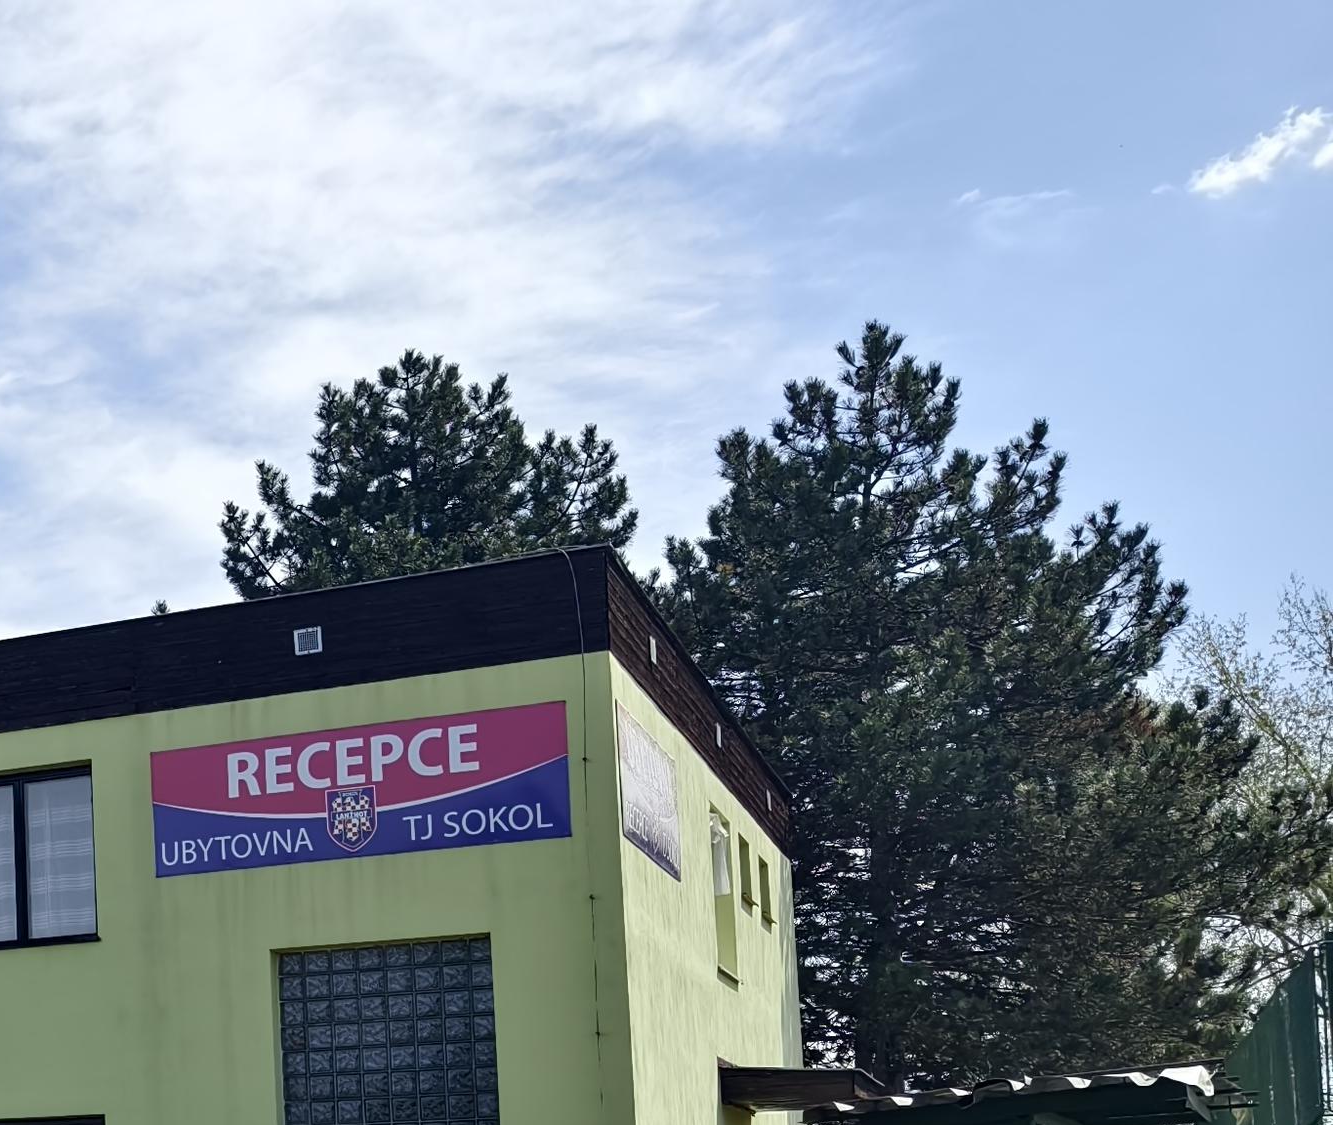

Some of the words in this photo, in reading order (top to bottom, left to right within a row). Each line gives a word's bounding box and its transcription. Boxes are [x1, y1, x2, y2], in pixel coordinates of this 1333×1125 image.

[226, 723, 481, 799] RECEPCE
[161, 827, 313, 867] UBYTOVNA
[403, 815, 433, 842] TJ
[443, 802, 554, 837] SOKOL
